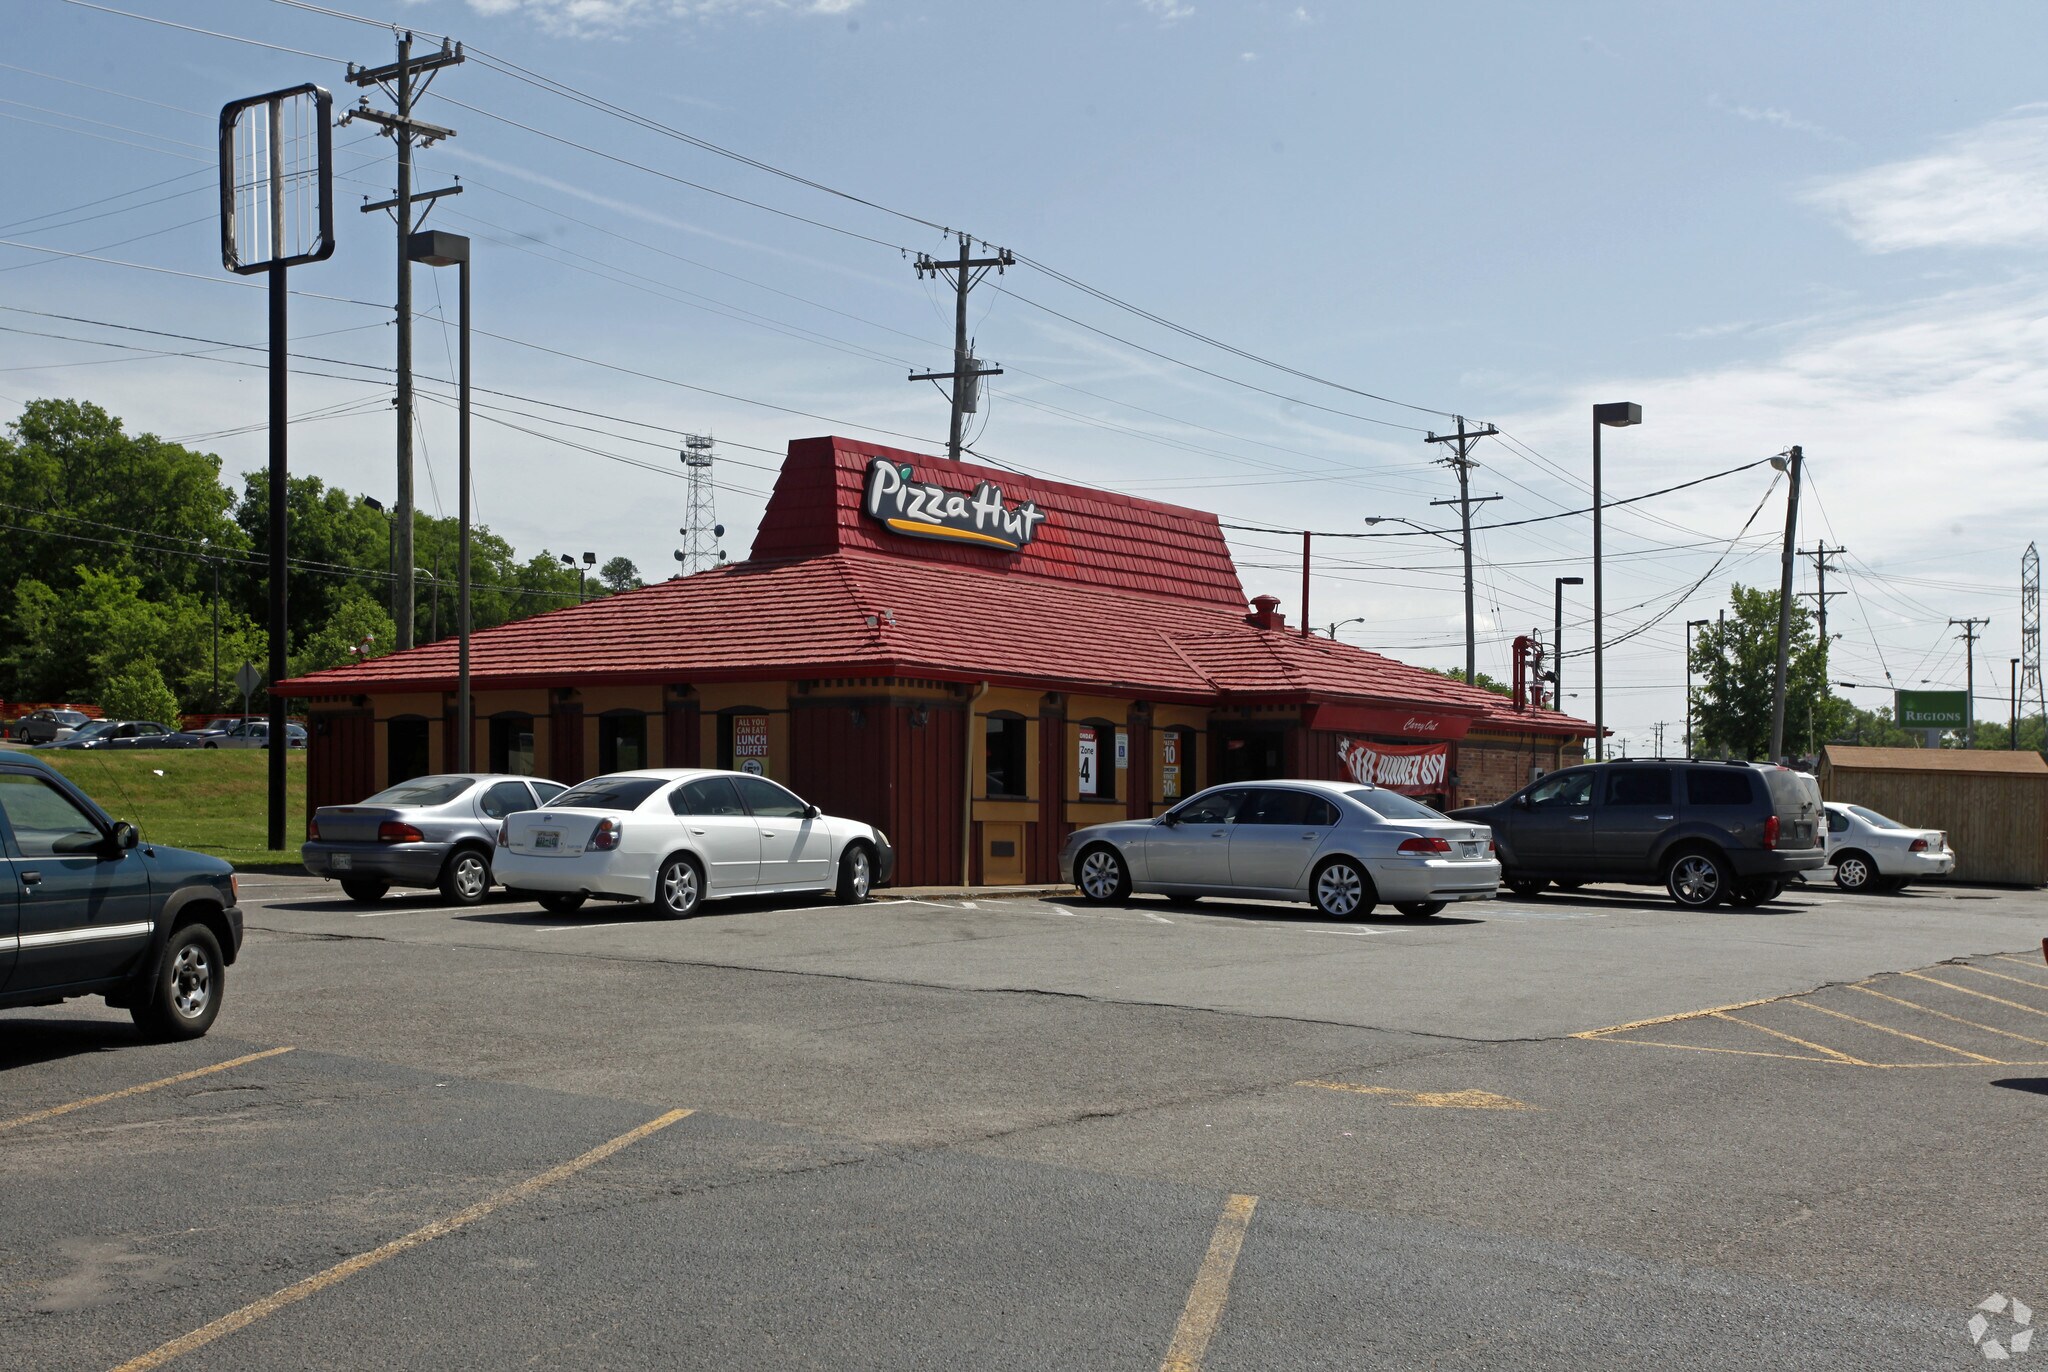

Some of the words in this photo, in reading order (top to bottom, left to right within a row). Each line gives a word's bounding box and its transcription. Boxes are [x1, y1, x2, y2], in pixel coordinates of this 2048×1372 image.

[872, 460, 969, 524] Pizza
[972, 485, 1045, 541] Hut
[1905, 711, 1960, 721] REGIONS
[1403, 717, 1425, 732] Carry
[1425, 720, 1439, 731] Out
[737, 735, 767, 745] LUNCH
[736, 745, 768, 755] BUFFET
[1163, 746, 1176, 764] 10
[1376, 753, 1421, 785] DINNER
